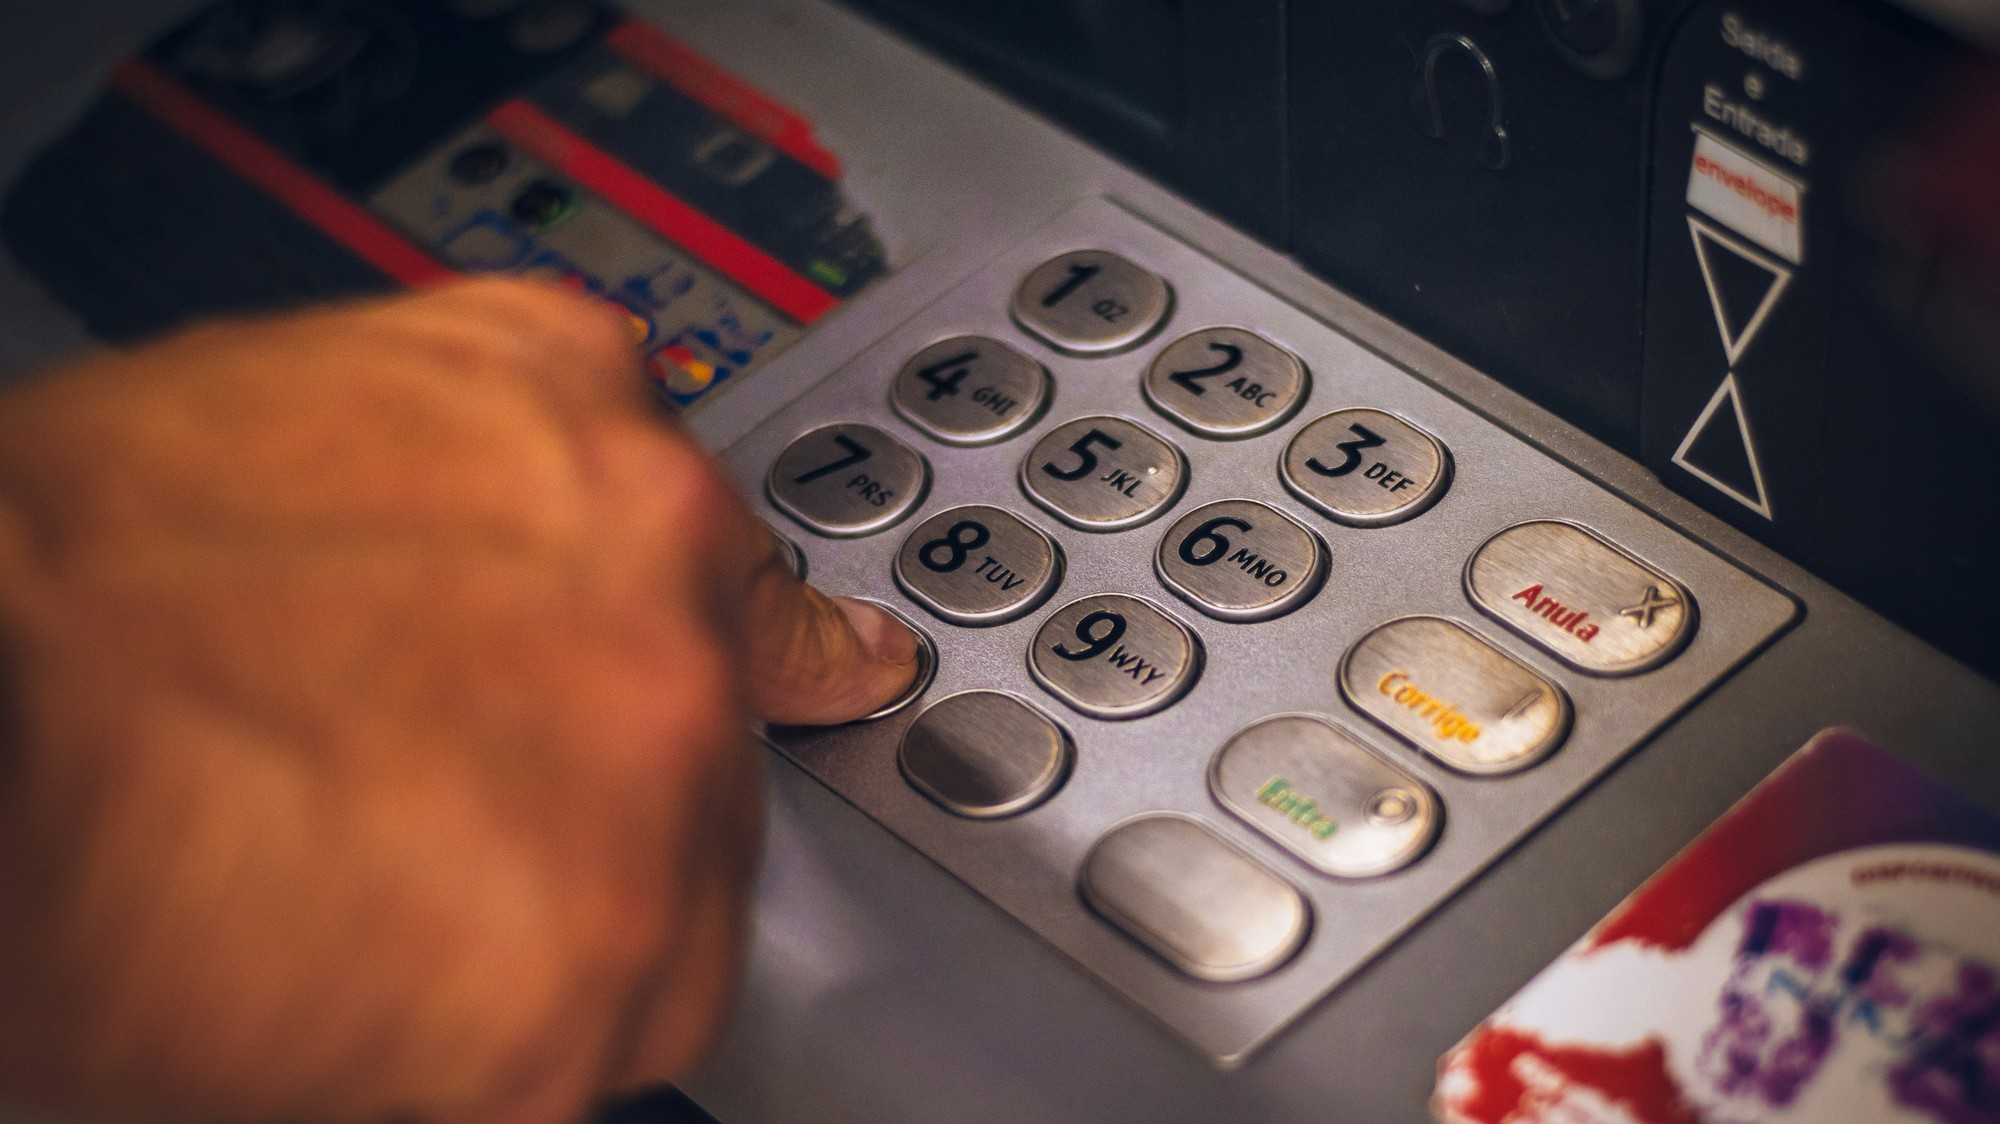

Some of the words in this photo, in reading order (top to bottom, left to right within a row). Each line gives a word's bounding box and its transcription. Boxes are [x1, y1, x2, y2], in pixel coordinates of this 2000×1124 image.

[1743, 74, 1764, 99] e
[1703, 84, 1807, 165] Entrada
[1694, 154, 1797, 220] envelope
[1042, 263, 1101, 308] 1
[916, 351, 979, 402] 4
[972, 386, 1018, 417] GHI
[1168, 342, 1243, 397] 2
[1224, 376, 1277, 409] ABC
[794, 433, 873, 483] 7
[846, 473, 894, 508] PRS
[1041, 428, 1123, 482] 5
[1100, 468, 1143, 499] JKL
[1304, 423, 1387, 478] 3
[1363, 461, 1415, 494] DEF
[917, 520, 991, 574] 8
[974, 555, 1026, 592] TUV
[1178, 516, 1254, 567] 6
[1227, 547, 1288, 588] MNO
[1051, 610, 1127, 662] 9
[1108, 644, 1166, 687] WXY
[1512, 584, 1601, 643] Anula
[1377, 670, 1482, 744] Corrige
[1256, 776, 1338, 840] Entra
